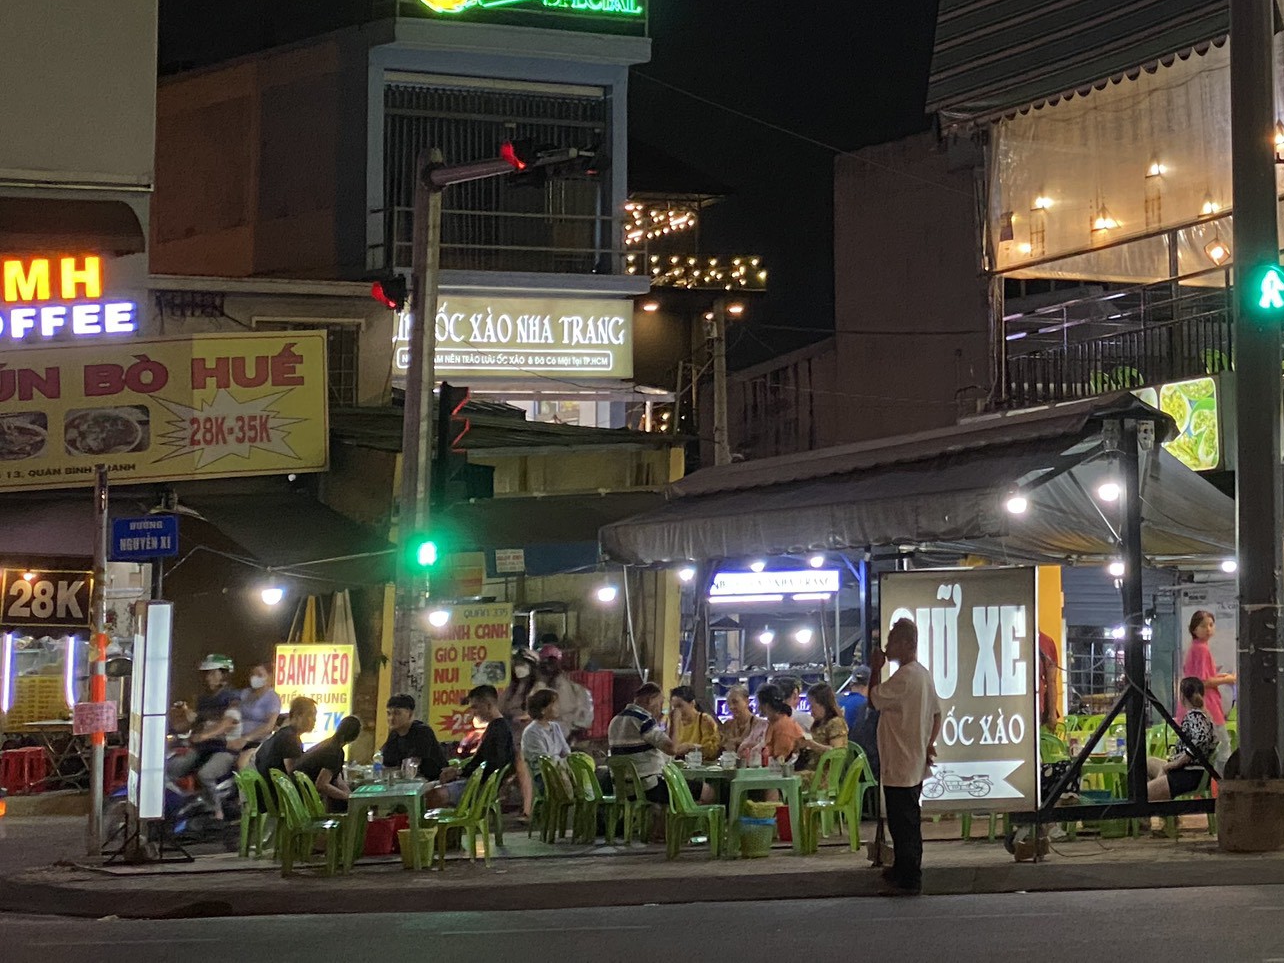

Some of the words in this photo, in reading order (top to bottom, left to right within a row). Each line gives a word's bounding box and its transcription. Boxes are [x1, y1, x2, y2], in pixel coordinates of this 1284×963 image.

[434, 301, 466, 343] ỐC
[468, 306, 513, 343] XÀO
[516, 314, 555, 344] NHA
[558, 315, 625, 346] TRANG
[83, 354, 169, 397] BÒ
[191, 343, 304, 390] HUẾ
[189, 415, 272, 446] 28K-35K
[7, 579, 85, 619] 28K
[276, 648, 317, 686] BÁNH
[321, 648, 349, 686] XÈO
[972, 604, 1027, 697] XE
[433, 667, 459, 684] NUI
[942, 706, 975, 747] ỐC
[979, 708, 1025, 745] XÀO
